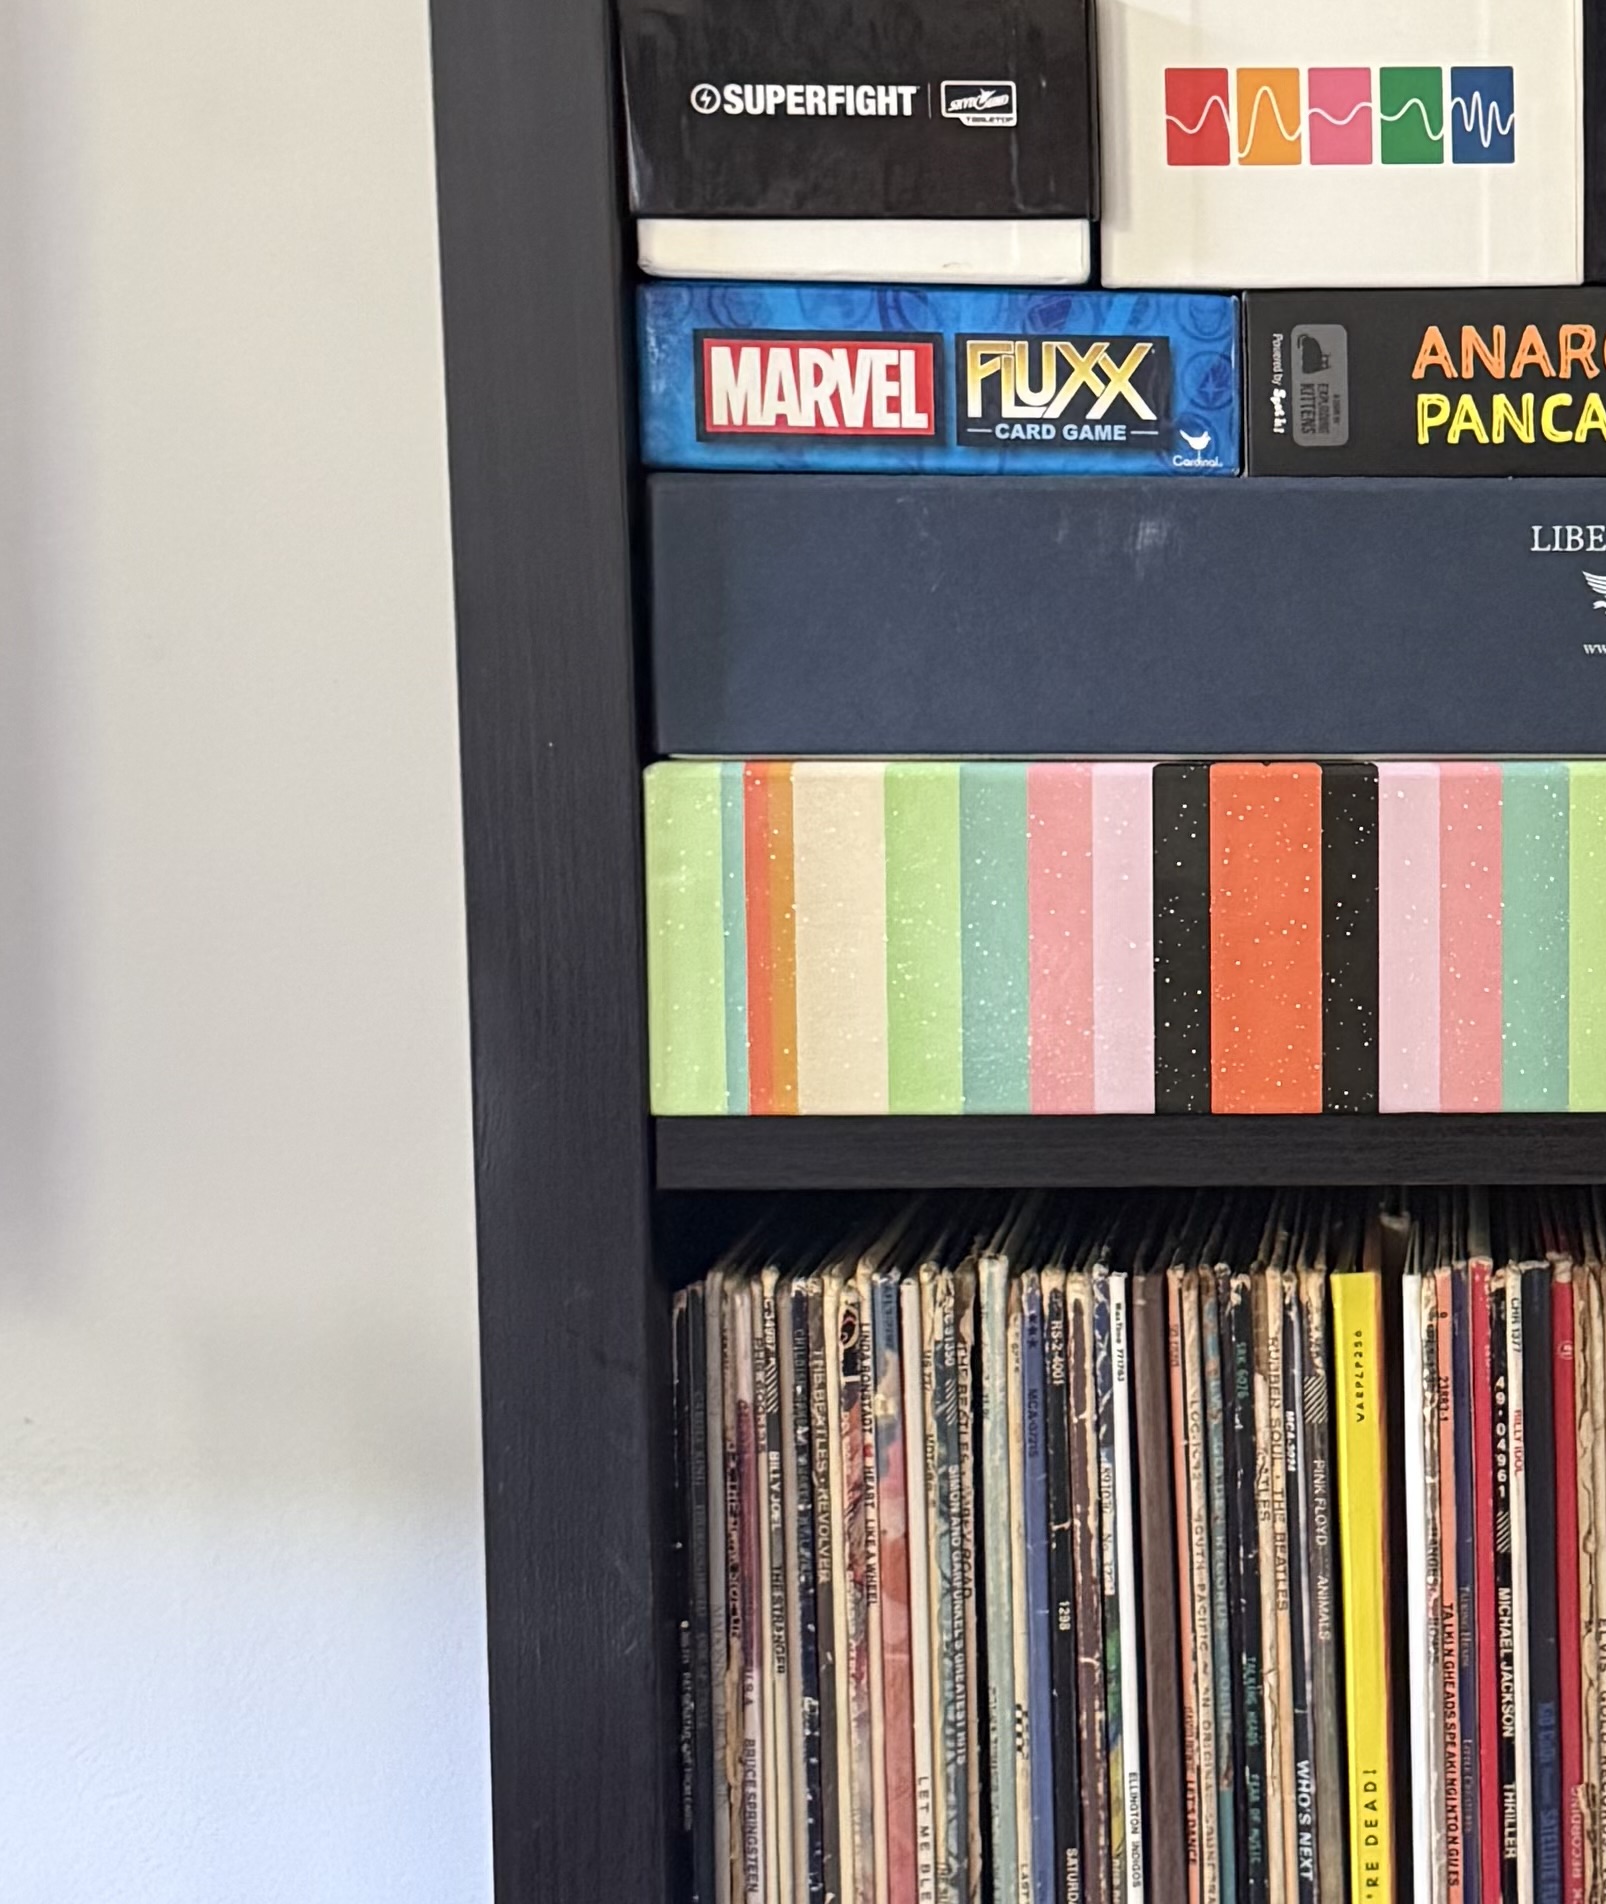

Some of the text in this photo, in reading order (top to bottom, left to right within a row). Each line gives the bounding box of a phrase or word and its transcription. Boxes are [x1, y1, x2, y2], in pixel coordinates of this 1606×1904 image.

[723, 84, 916, 116] SUPERFIGHT
[710, 346, 929, 428] MARVEL
[966, 340, 1157, 421] FLUXX
[1271, 333, 1283, 386] Powered by
[994, 423, 1127, 441] CARD GAME
[1300, 383, 1317, 434] KITTENS
[1172, 454, 1222, 467] Cardinal
[812, 1349, 831, 1583] THE BEATLES REVOLVER
[859, 1322, 878, 1607] LINDA RONSTADT HEART LIKE A WHEEL
[768, 1451, 785, 1674] BILLY JOEL THE STRANGER
[1313, 1460, 1330, 1640] PINK FLOYD ANIMALS
[1499, 1588, 1518, 1858] MICHAEL JACKSON THRILLER
[744, 1739, 759, 1892] BRUCE SPRINGSTEEN
[918, 1776, 929, 1813] LET
[1128, 1772, 1140, 1835] ELLINGTON
[1297, 1760, 1311, 1824] WHO'S
[1363, 1769, 1377, 1847] DEAD!
[919, 1825, 930, 1853] ME
[1131, 1841, 1142, 1887] INDIGOS
[1299, 1831, 1312, 1881] NEXT
[1570, 1786, 1582, 1879] RECORDING
